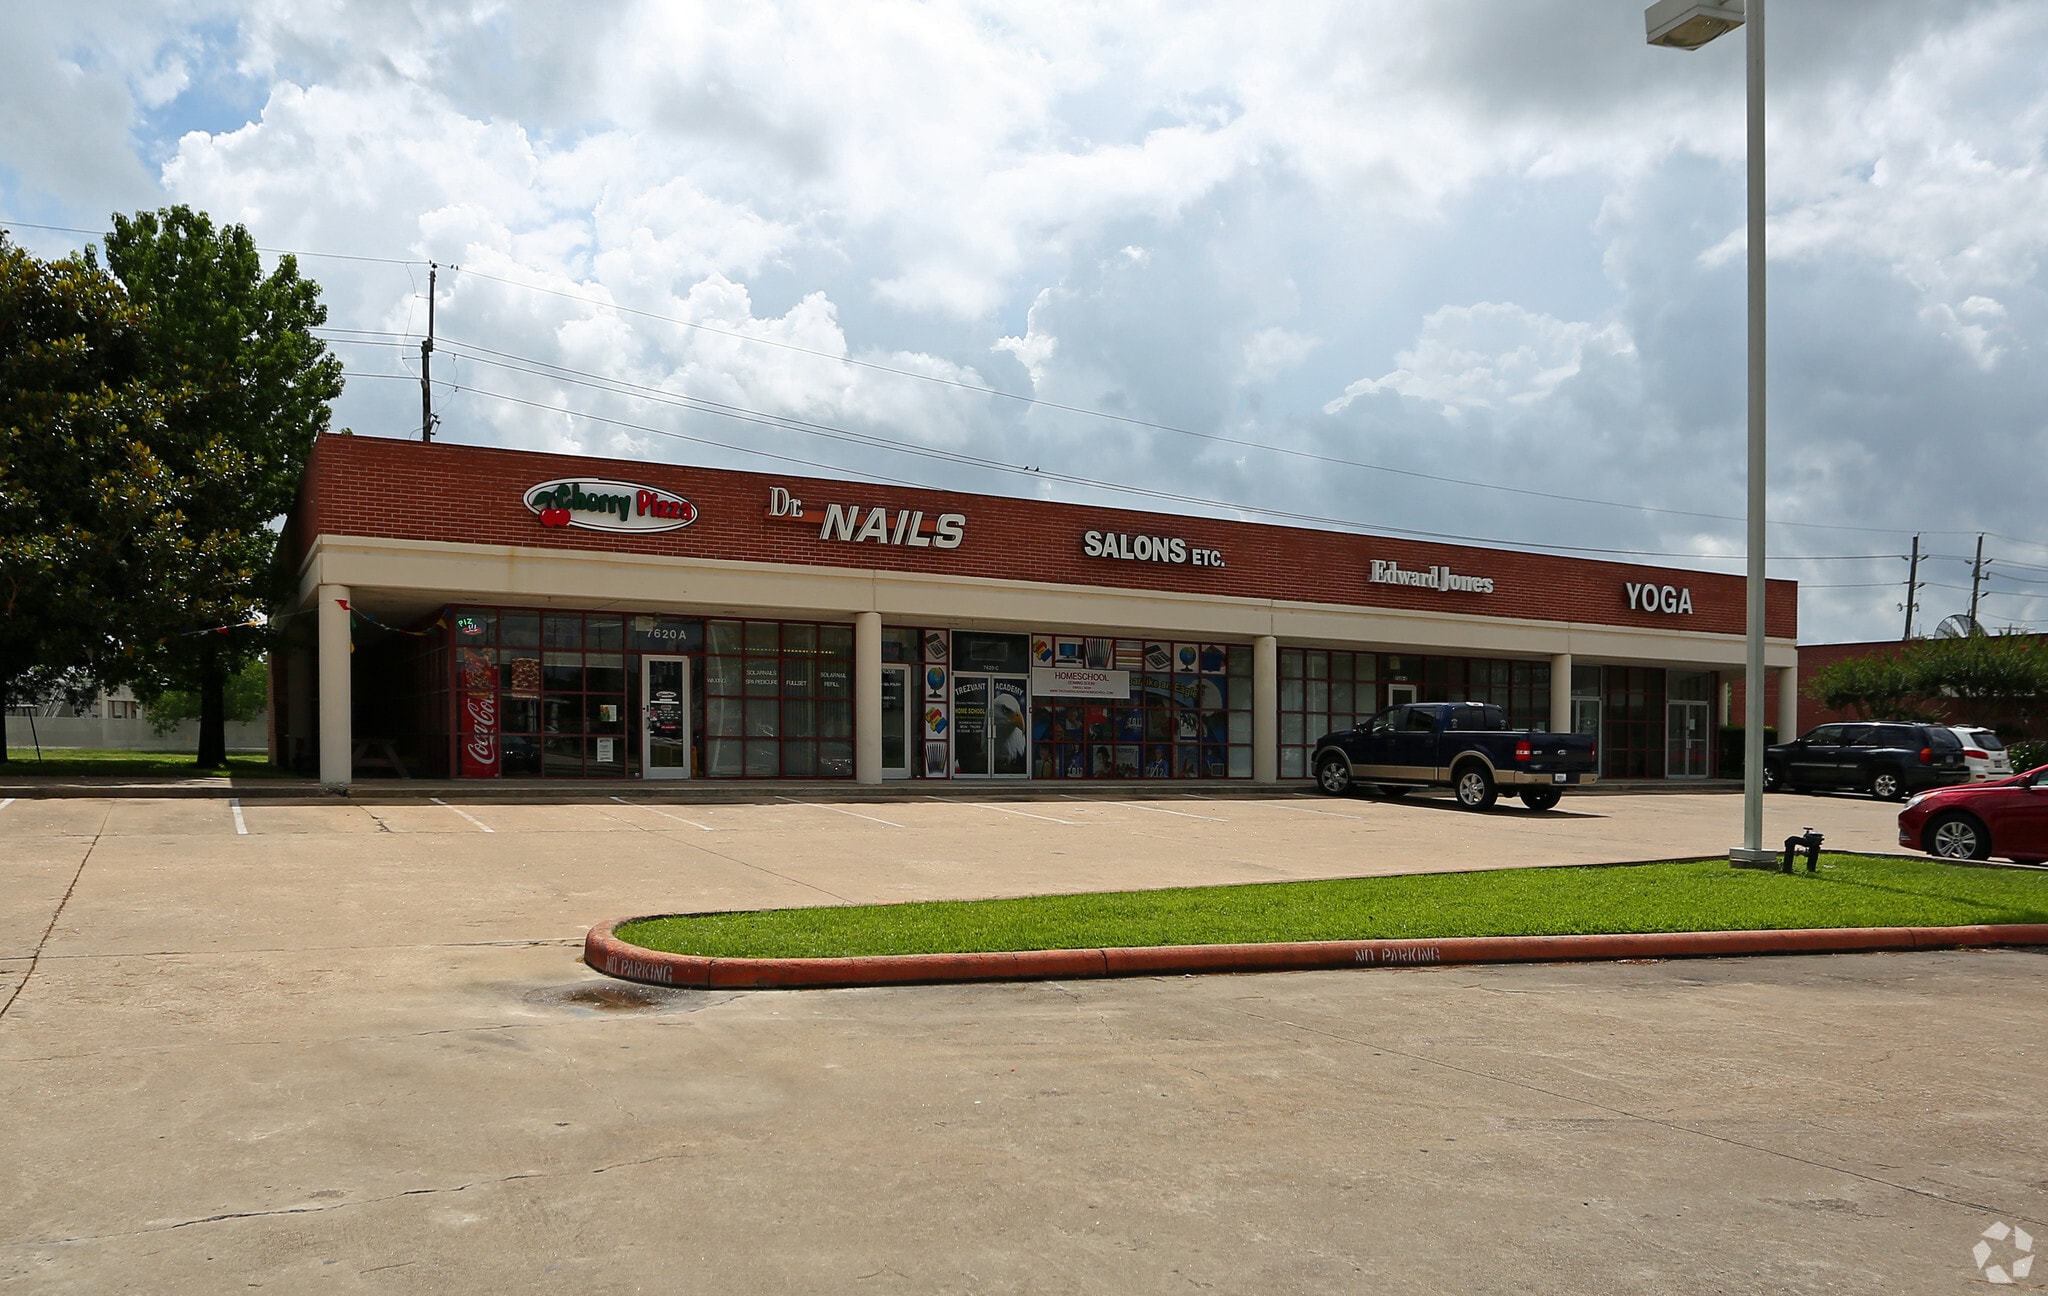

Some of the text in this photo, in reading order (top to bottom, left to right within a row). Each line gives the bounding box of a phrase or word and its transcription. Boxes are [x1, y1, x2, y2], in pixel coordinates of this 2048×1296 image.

[555, 482, 692, 521] Cherry Pizza
[819, 504, 966, 549] NAILS
[1084, 530, 1226, 567] SALONS ETC.
[1370, 560, 1494, 593] Edward Jones
[1626, 582, 1693, 614] YOGA
[955, 682, 1024, 696] TREZVANT ACADEMY
[1055, 671, 1109, 681] HOMESCHOOL
[1174, 682, 1198, 698] Eagle
[1355, 947, 1440, 961] NO PARKING
[606, 956, 673, 983] NO PARKING
